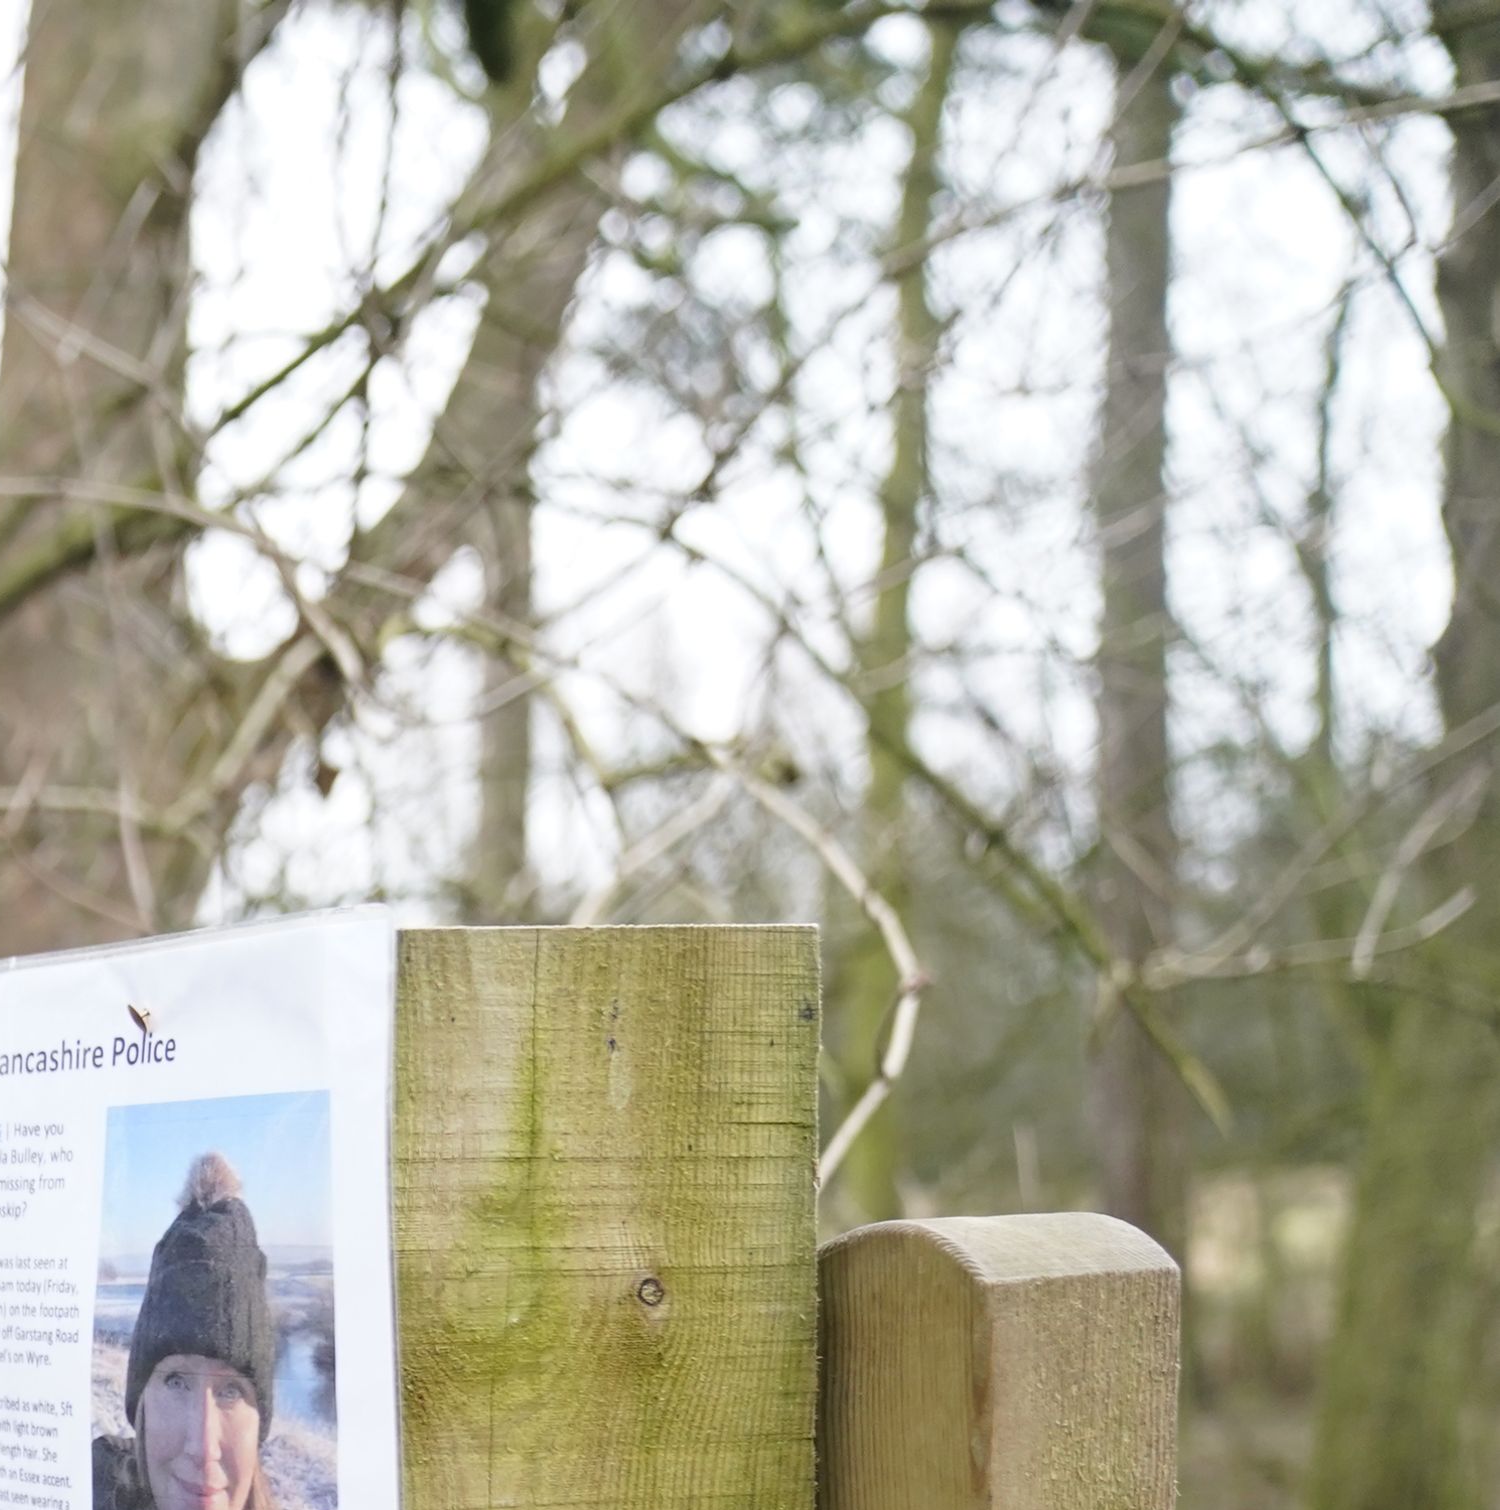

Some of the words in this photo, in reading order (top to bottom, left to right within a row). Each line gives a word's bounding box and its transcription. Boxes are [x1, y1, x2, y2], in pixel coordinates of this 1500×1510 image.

[112, 1031, 177, 1067] Police
[13, 1121, 41, 1137] Have
[43, 1122, 65, 1140] you
[10, 1147, 47, 1168] Bulley,
[50, 1146, 74, 1163] who
[38, 1174, 66, 1191] from
[15, 1255, 31, 1271] last
[33, 1258, 56, 1271] seen
[58, 1256, 69, 1271] at
[15, 1279, 42, 1297] today
[43, 1278, 80, 1297] (Friday,
[8, 1304, 21, 1317] on
[21, 1303, 37, 1318] the
[39, 1301, 81, 1320] footpath
[1, 1324, 14, 1341] off
[14, 1326, 54, 1347] Garstang
[55, 1328, 80, 1344] Road
[13, 1351, 25, 1364] on
[25, 1350, 52, 1369] Wyre.
[22, 1400, 31, 1413] as
[31, 1399, 58, 1418] white,
[60, 1400, 74, 1417] 5ft
[12, 1419, 30, 1439] light
[30, 1421, 59, 1438] brown
[42, 1446, 58, 1463] She
[19, 1467, 41, 1485] Essex
[42, 1473, 73, 1489] accent.
[11, 1491, 30, 1505] seen
